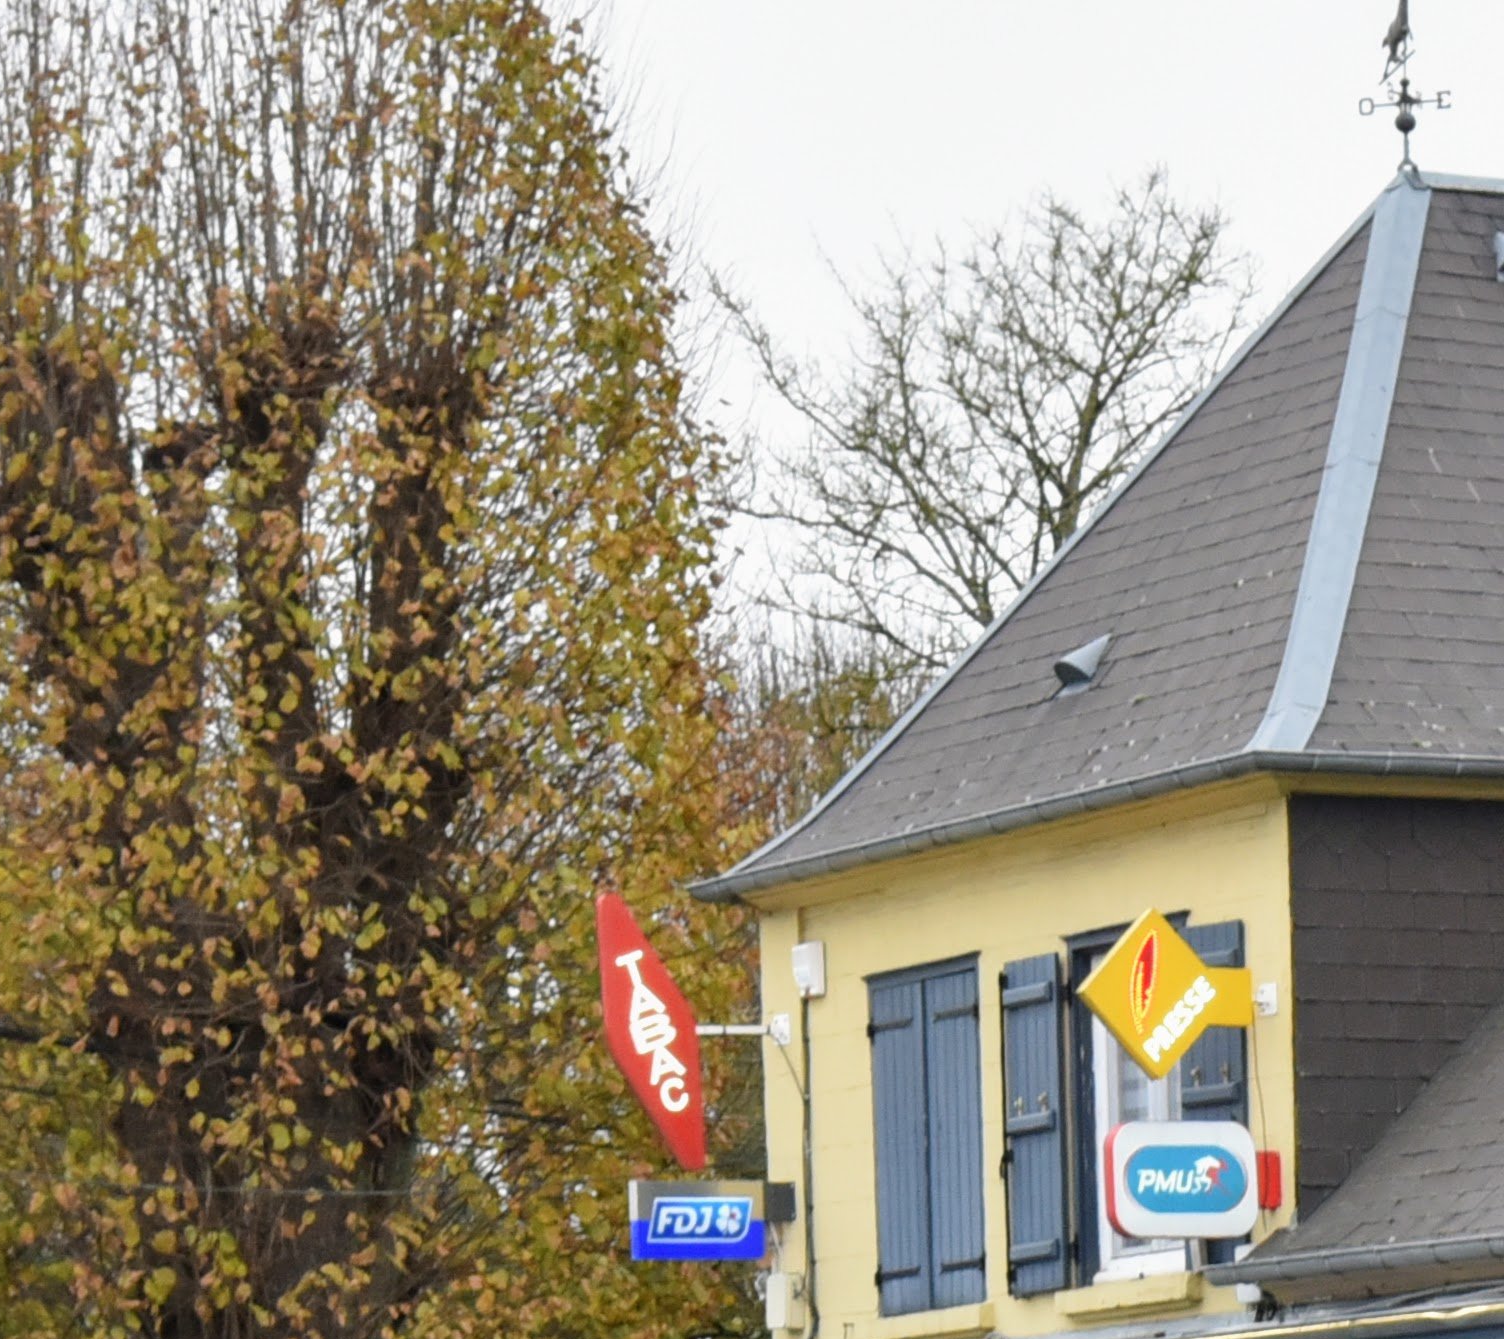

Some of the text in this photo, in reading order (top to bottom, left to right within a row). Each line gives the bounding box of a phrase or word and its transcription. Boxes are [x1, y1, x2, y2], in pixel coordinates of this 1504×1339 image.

[613, 949, 690, 1113] TABAC
[1136, 1168, 1194, 1195] PMU
[655, 1206, 715, 1236] FDJ
